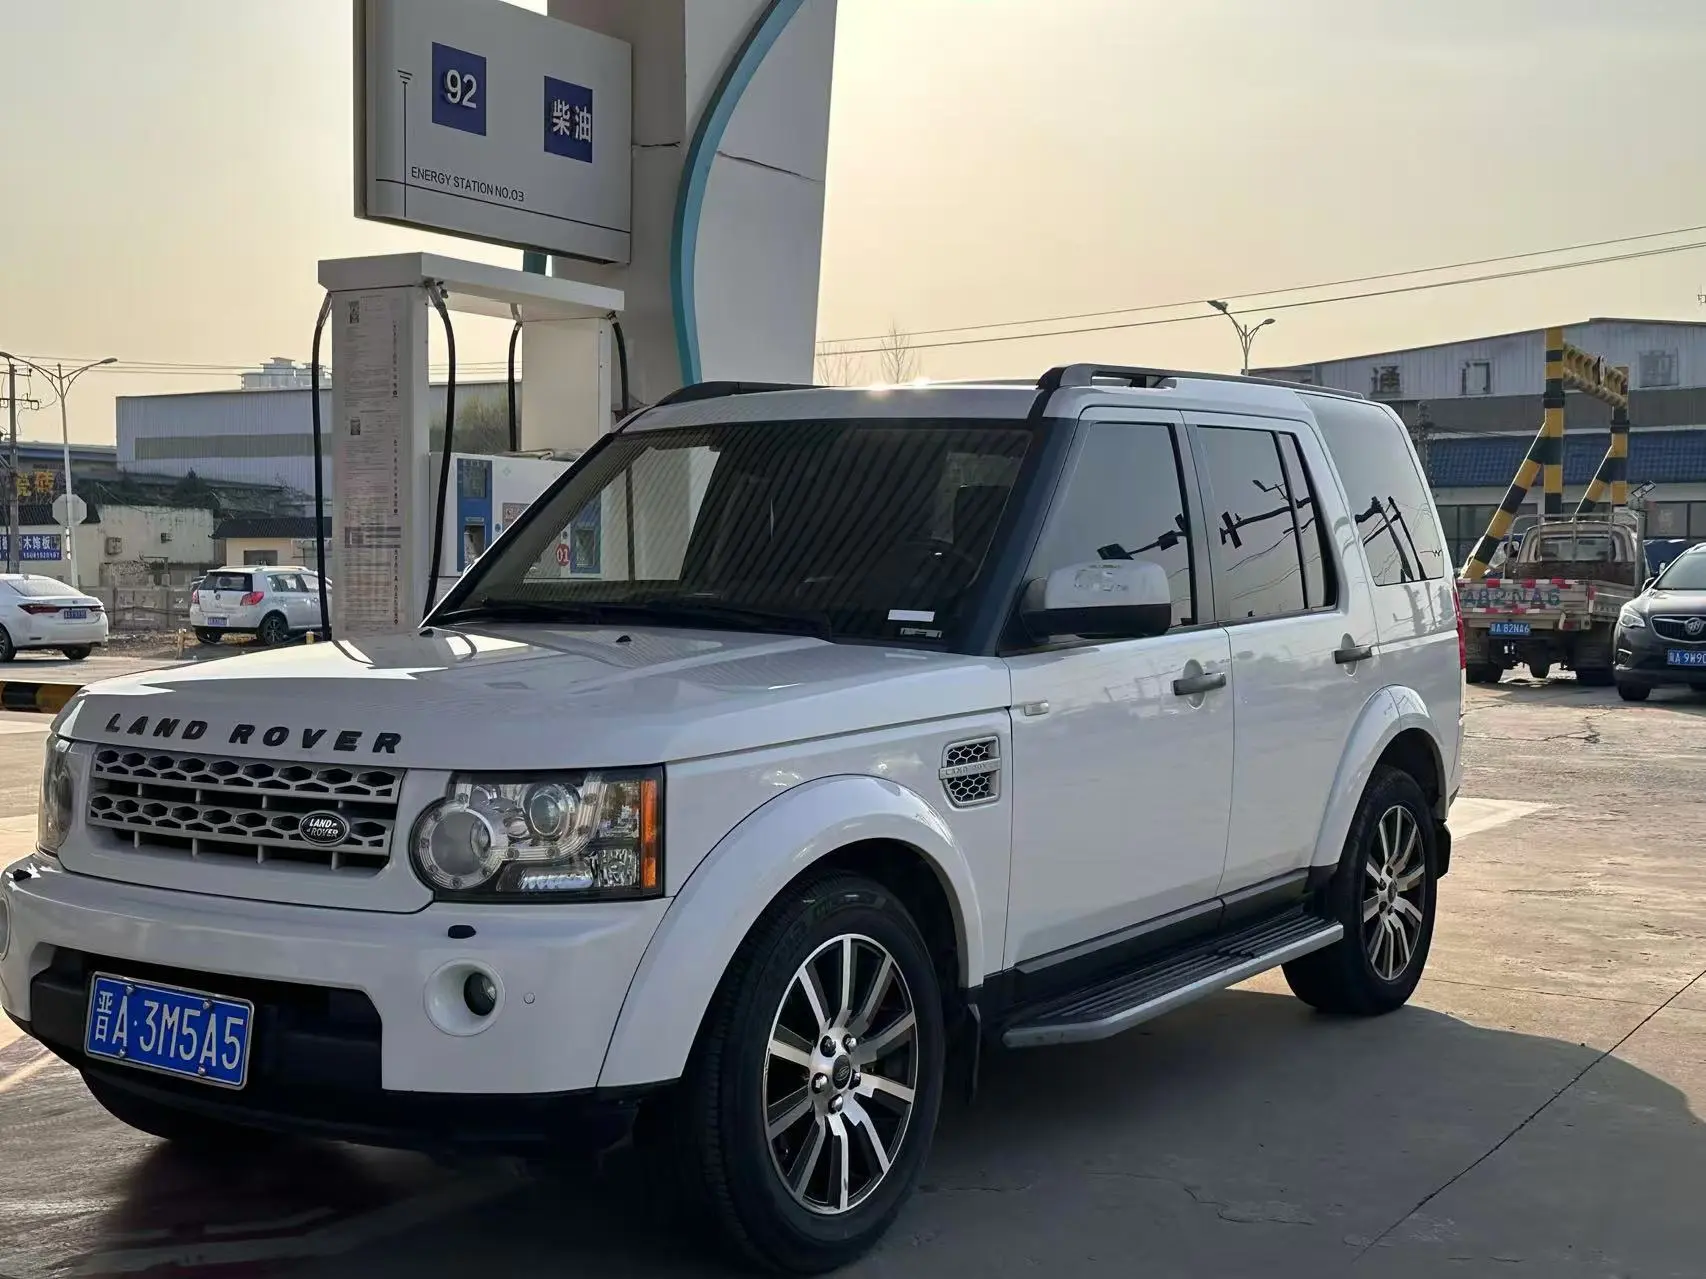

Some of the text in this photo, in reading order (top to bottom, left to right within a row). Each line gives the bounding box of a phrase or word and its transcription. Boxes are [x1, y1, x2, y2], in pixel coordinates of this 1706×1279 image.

[446, 69, 477, 109] 92
[552, 99, 592, 143] 柴油
[411, 166, 525, 202] ENERGY STATION NO.03
[104, 714, 402, 754] LAND ROVER
[310, 818, 332, 828] LAND
[310, 828, 339, 838] ROVER
